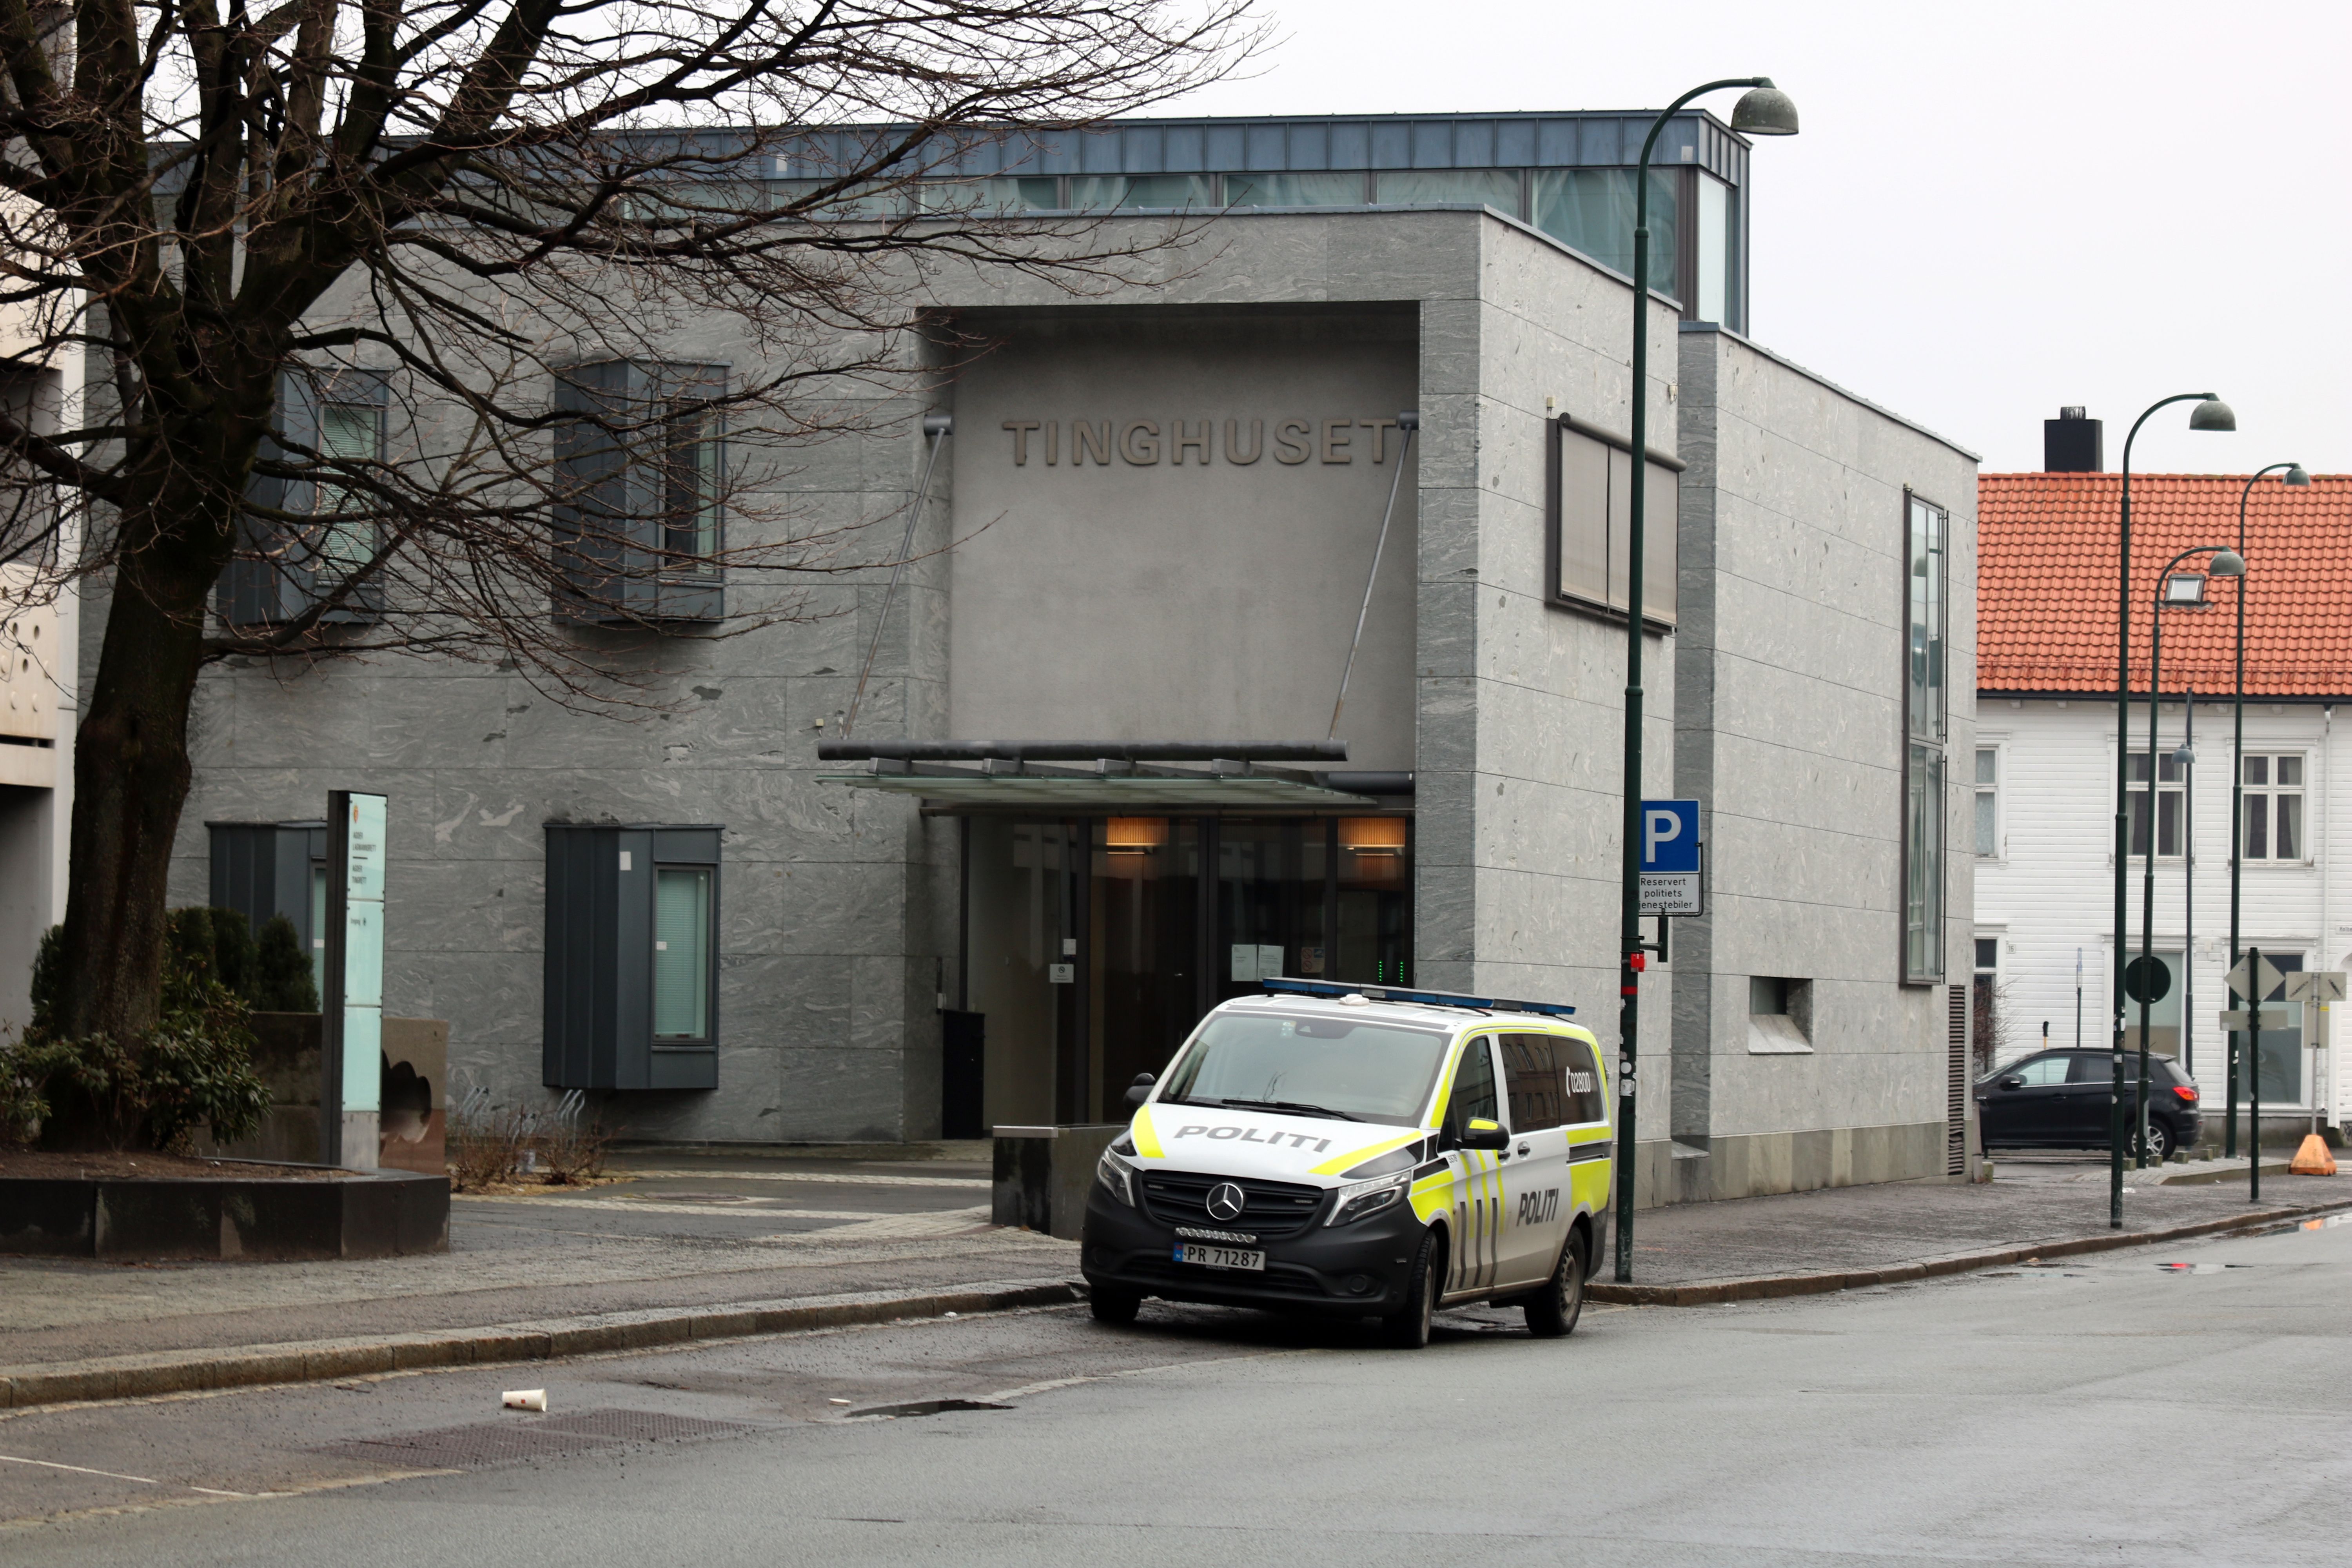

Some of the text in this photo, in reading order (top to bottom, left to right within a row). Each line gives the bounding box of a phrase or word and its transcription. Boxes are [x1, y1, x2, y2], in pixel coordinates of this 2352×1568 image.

[1002, 418, 1397, 466] TINGHUSET
[1646, 810, 1682, 863] P
[1641, 877, 1686, 886] Reservert
[1644, 889, 1682, 899] politiets
[1639, 900, 1692, 910] jenestebiler
[1570, 1072, 1591, 1093] 02800
[1173, 1125, 1332, 1153] POLITI
[1516, 1188, 1559, 1227] POLITI
[1187, 1246, 1206, 1262] PR
[1214, 1249, 1259, 1267] 71287
